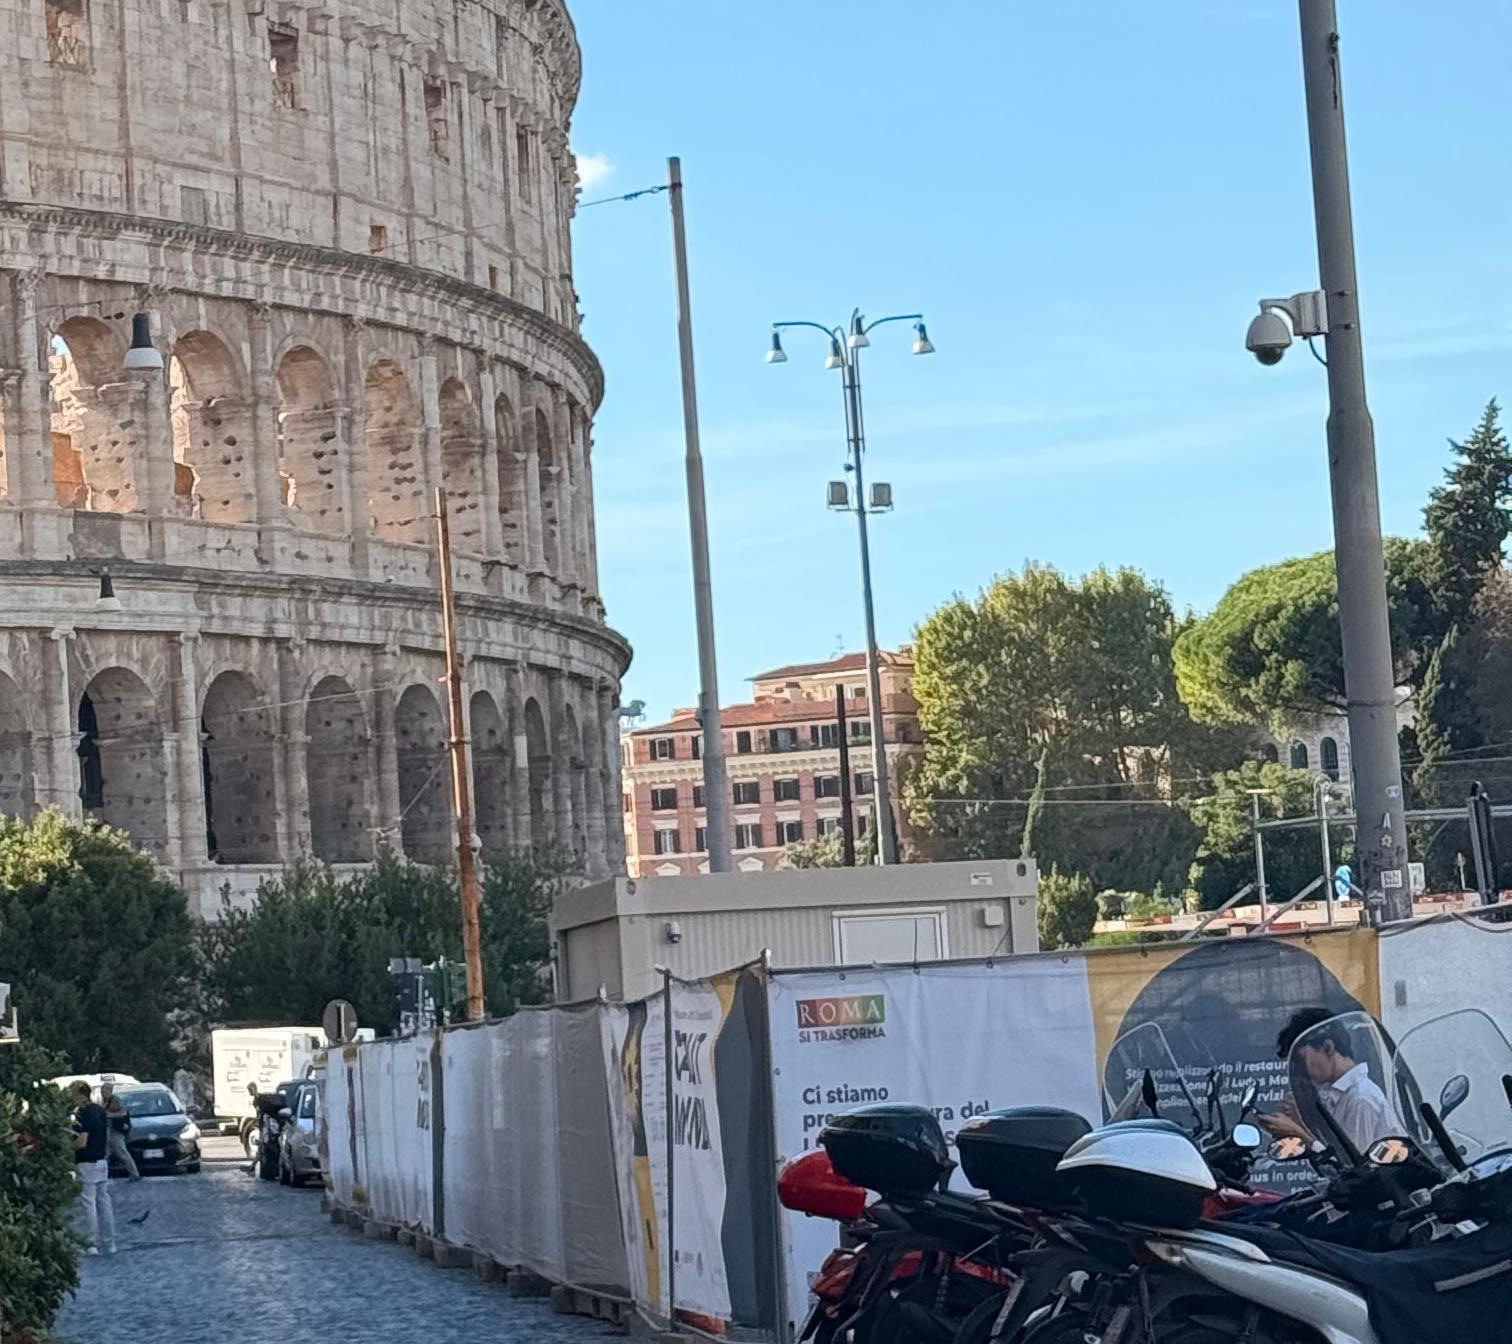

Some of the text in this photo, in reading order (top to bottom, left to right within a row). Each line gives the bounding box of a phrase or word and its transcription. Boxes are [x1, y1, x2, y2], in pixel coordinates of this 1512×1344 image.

[798, 999, 882, 1027] ROMA
[798, 1026, 886, 1044] SI TRASFORMA
[1244, 1060, 1288, 1073] restaur
[802, 1084, 888, 1106] Ci stiamo
[1287, 1169, 1316, 1183] orde
